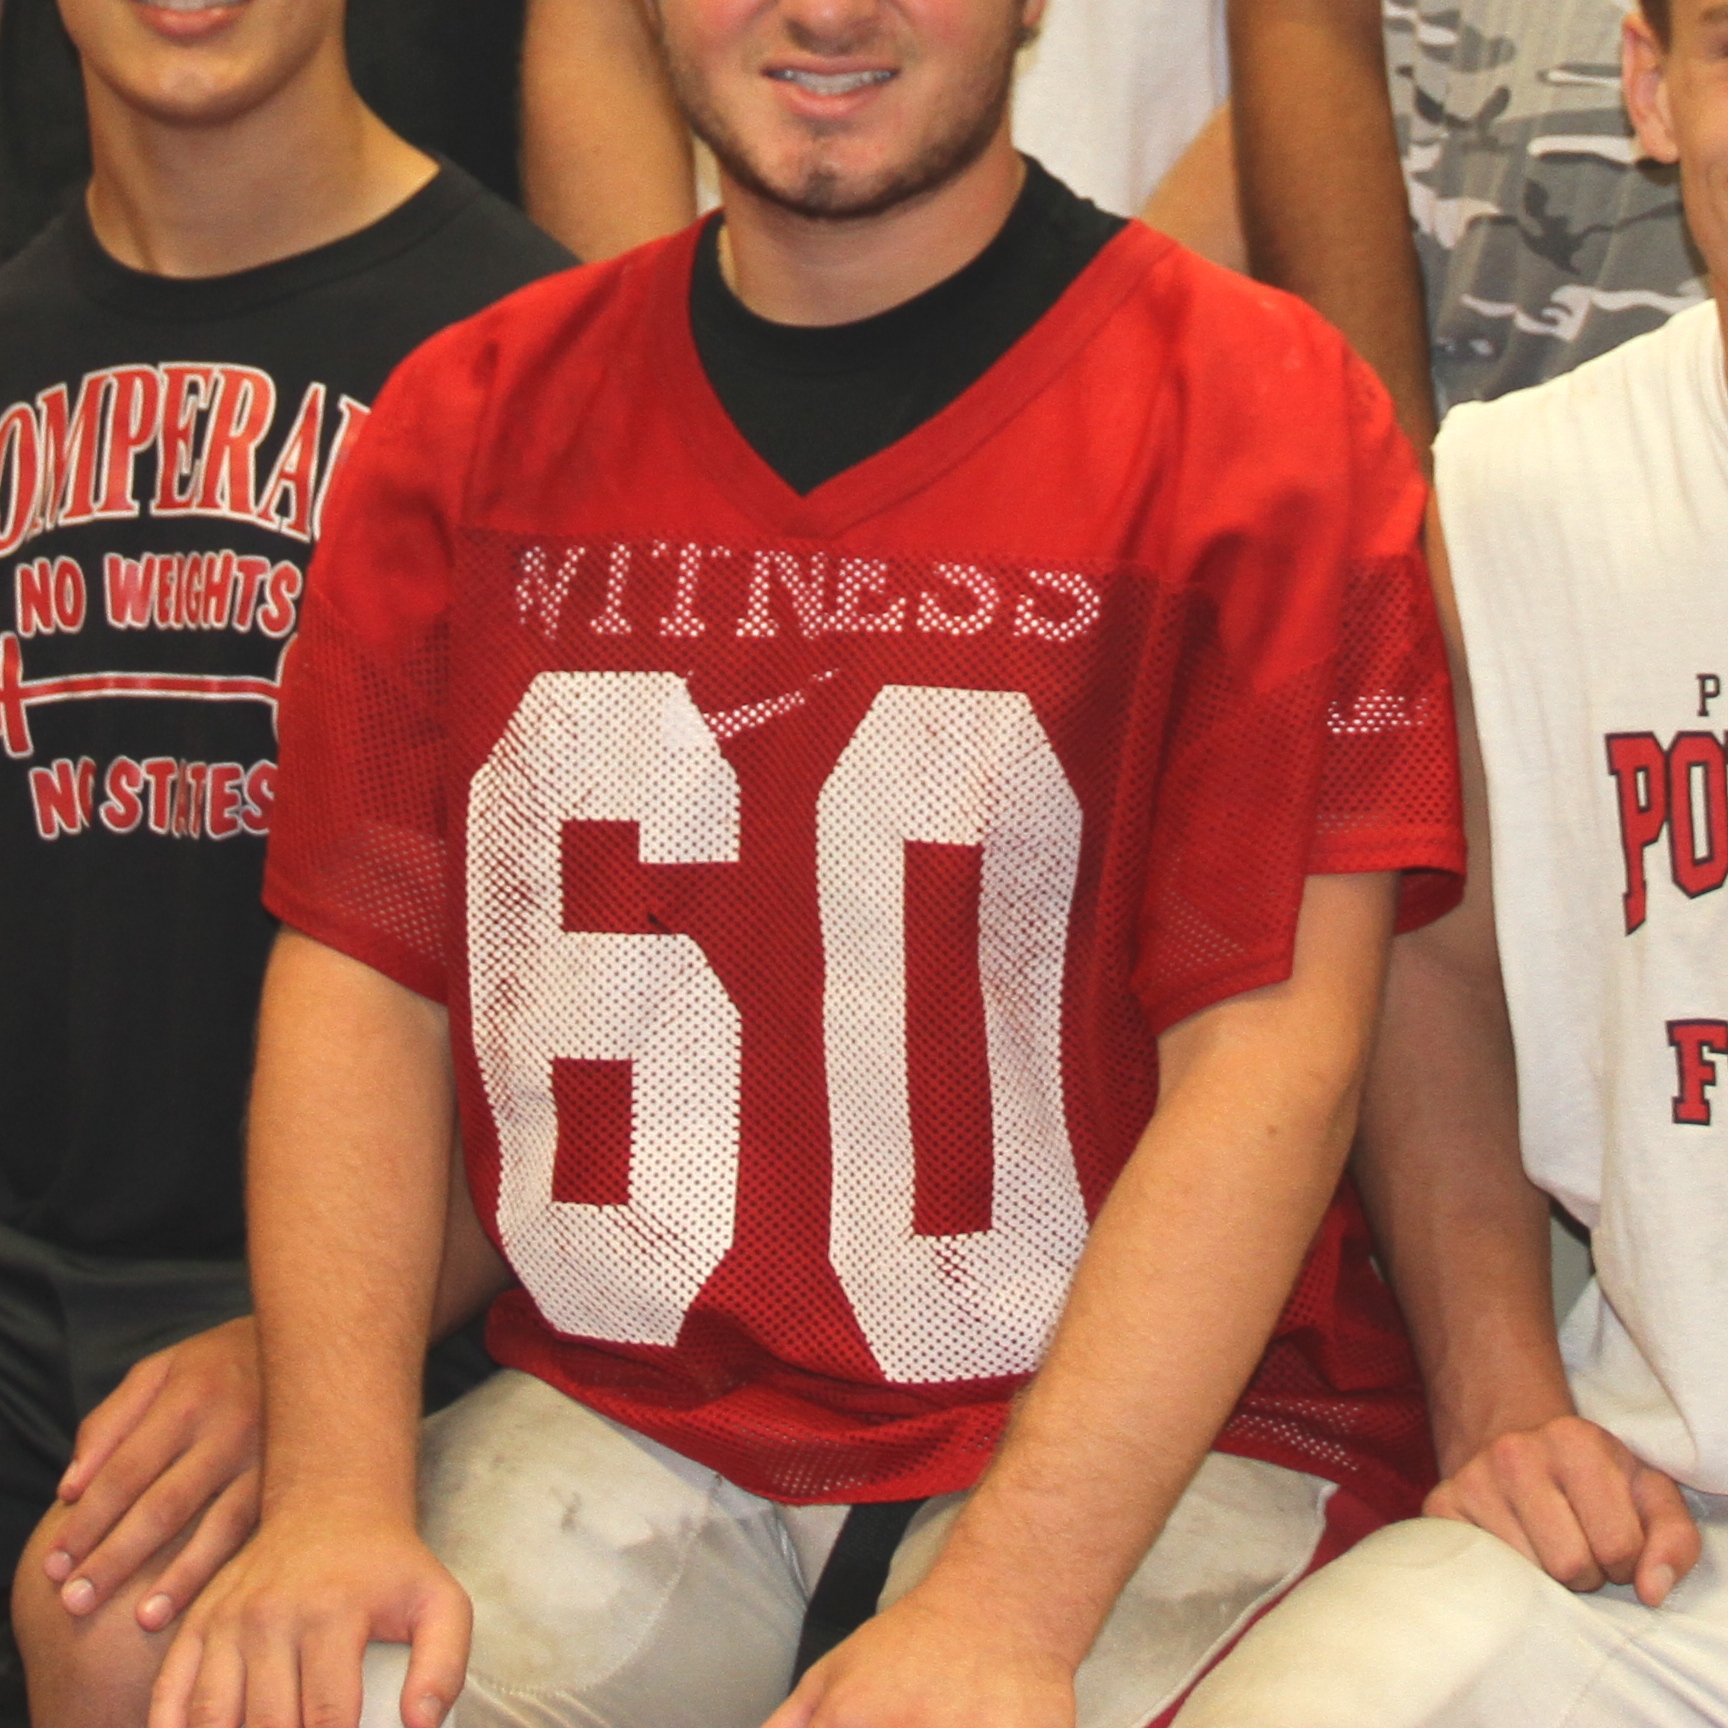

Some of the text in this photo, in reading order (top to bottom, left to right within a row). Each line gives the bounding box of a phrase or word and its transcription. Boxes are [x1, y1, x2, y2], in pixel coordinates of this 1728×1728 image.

[16, 549, 303, 638] NO WEIGHTS
[513, 541, 1103, 643] WITNESS
[466, 670, 1090, 1384] 60
